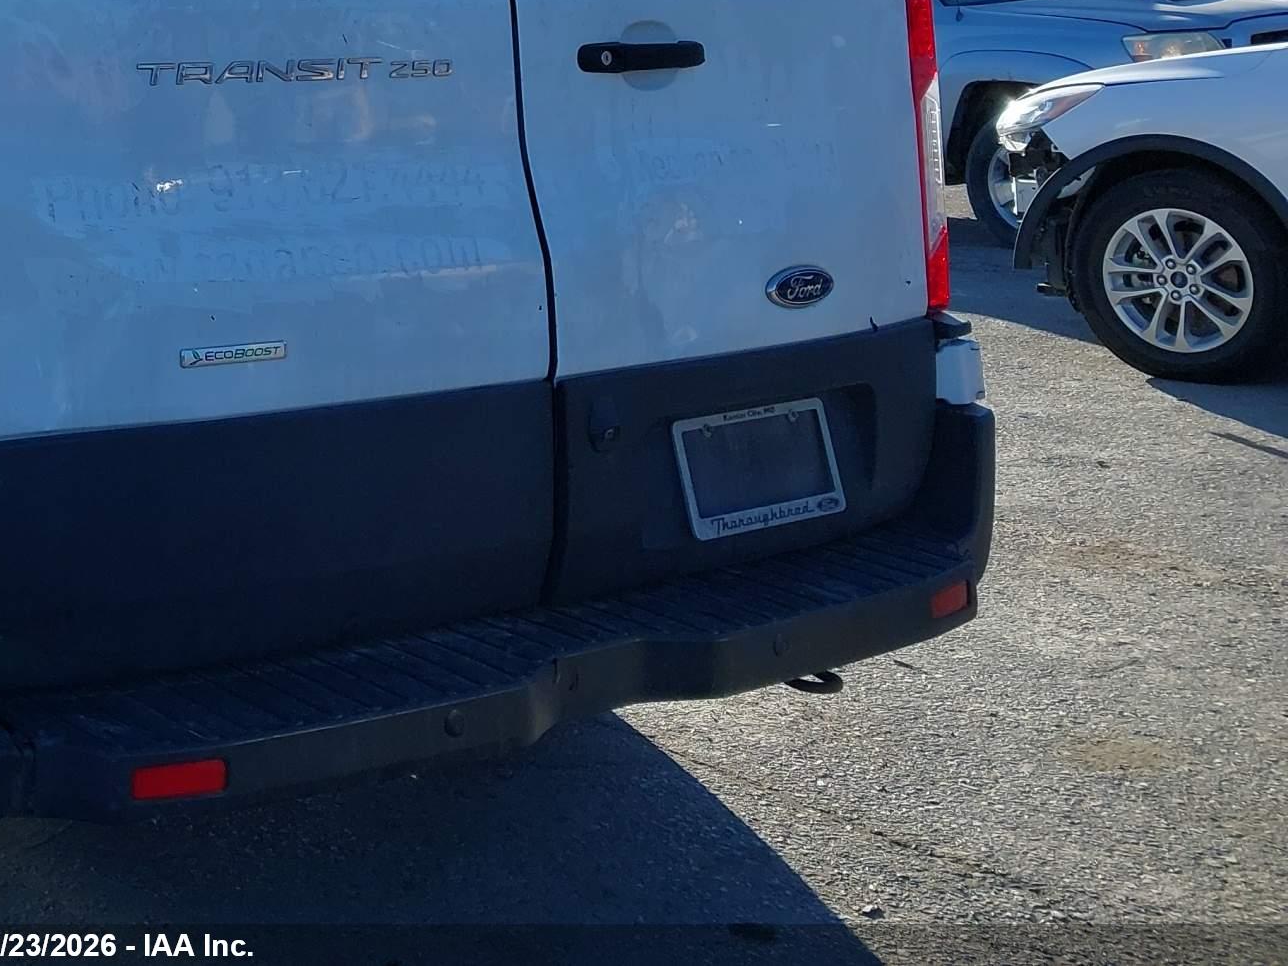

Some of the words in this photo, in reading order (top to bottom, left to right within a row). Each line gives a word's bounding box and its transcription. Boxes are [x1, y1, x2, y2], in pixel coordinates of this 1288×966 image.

[136, 56, 383, 86] TRANSIT
[388, 59, 454, 79] 250
[787, 274, 823, 300] Ford
[711, 500, 816, 535] Thoroughbred
